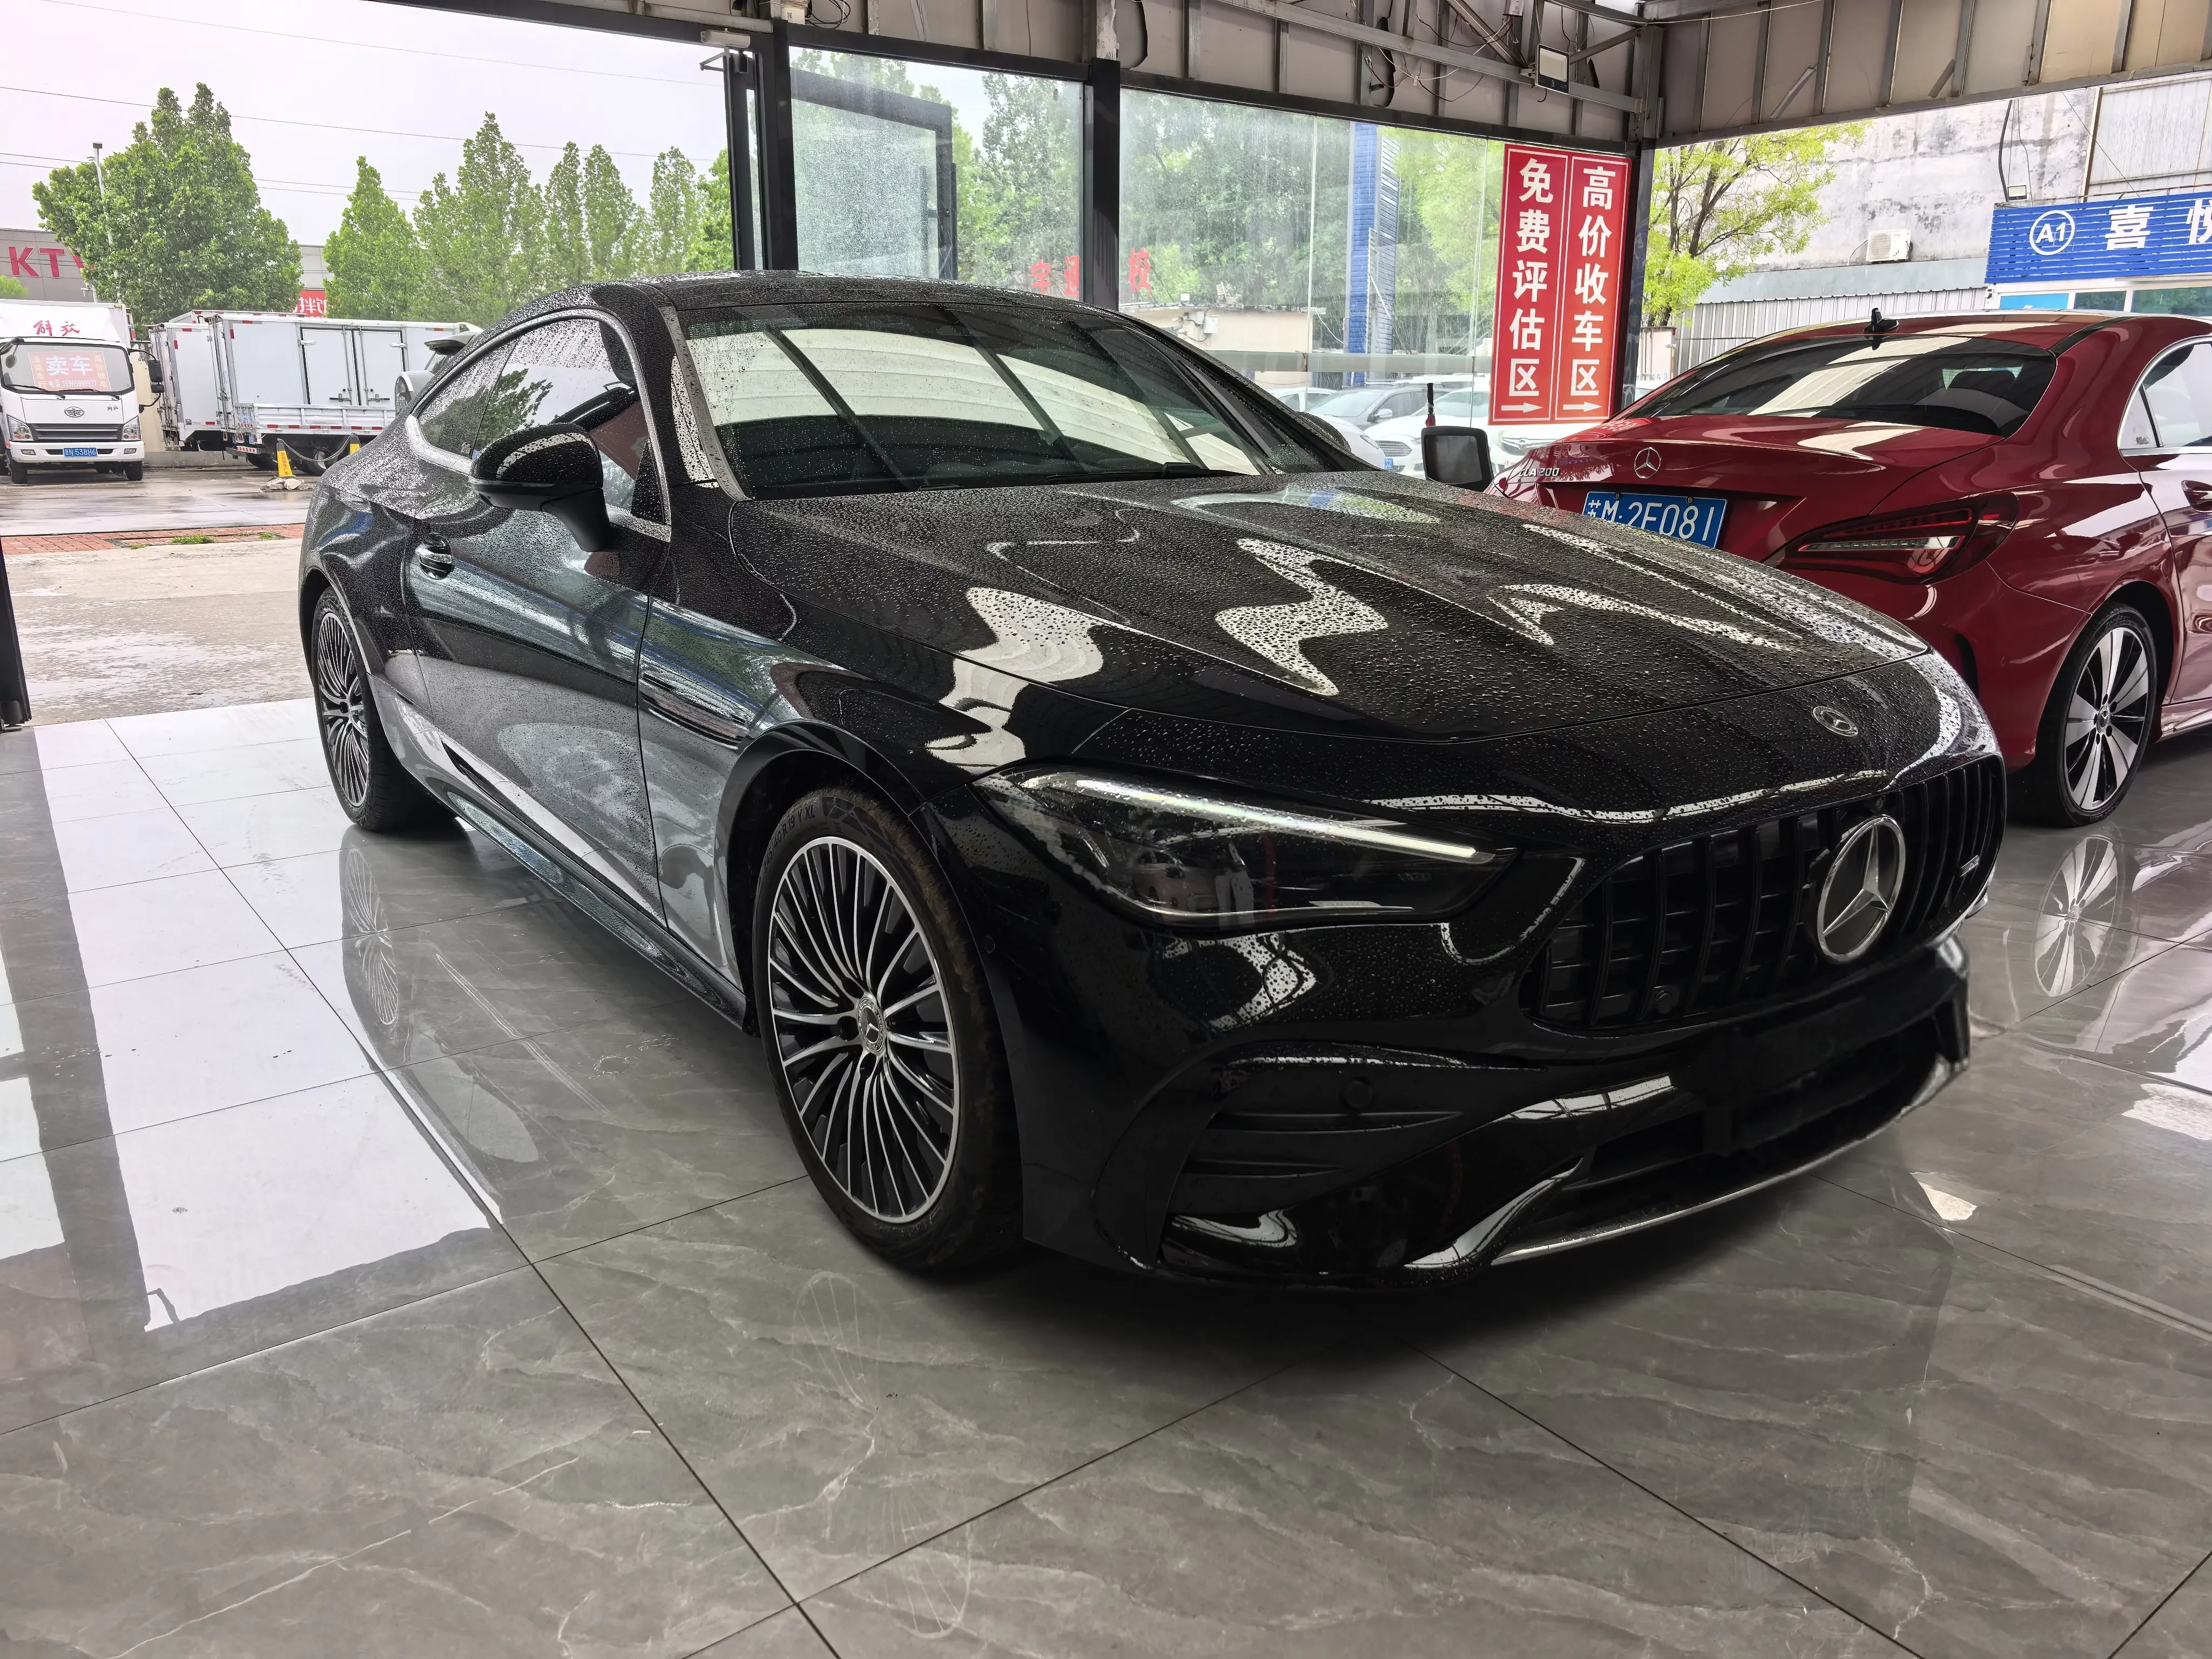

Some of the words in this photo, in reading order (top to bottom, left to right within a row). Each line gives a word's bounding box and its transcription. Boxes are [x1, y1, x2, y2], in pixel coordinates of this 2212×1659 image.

[2035, 222, 2066, 244] A1
[1508, 157, 1554, 397] 免费评估区
[1570, 166, 1616, 396] 高价收车区
[45, 355, 93, 376] 卖车
[1518, 468, 1536, 477] CLA
[1538, 468, 1560, 477] 200
[805, 805, 816, 820] XL
